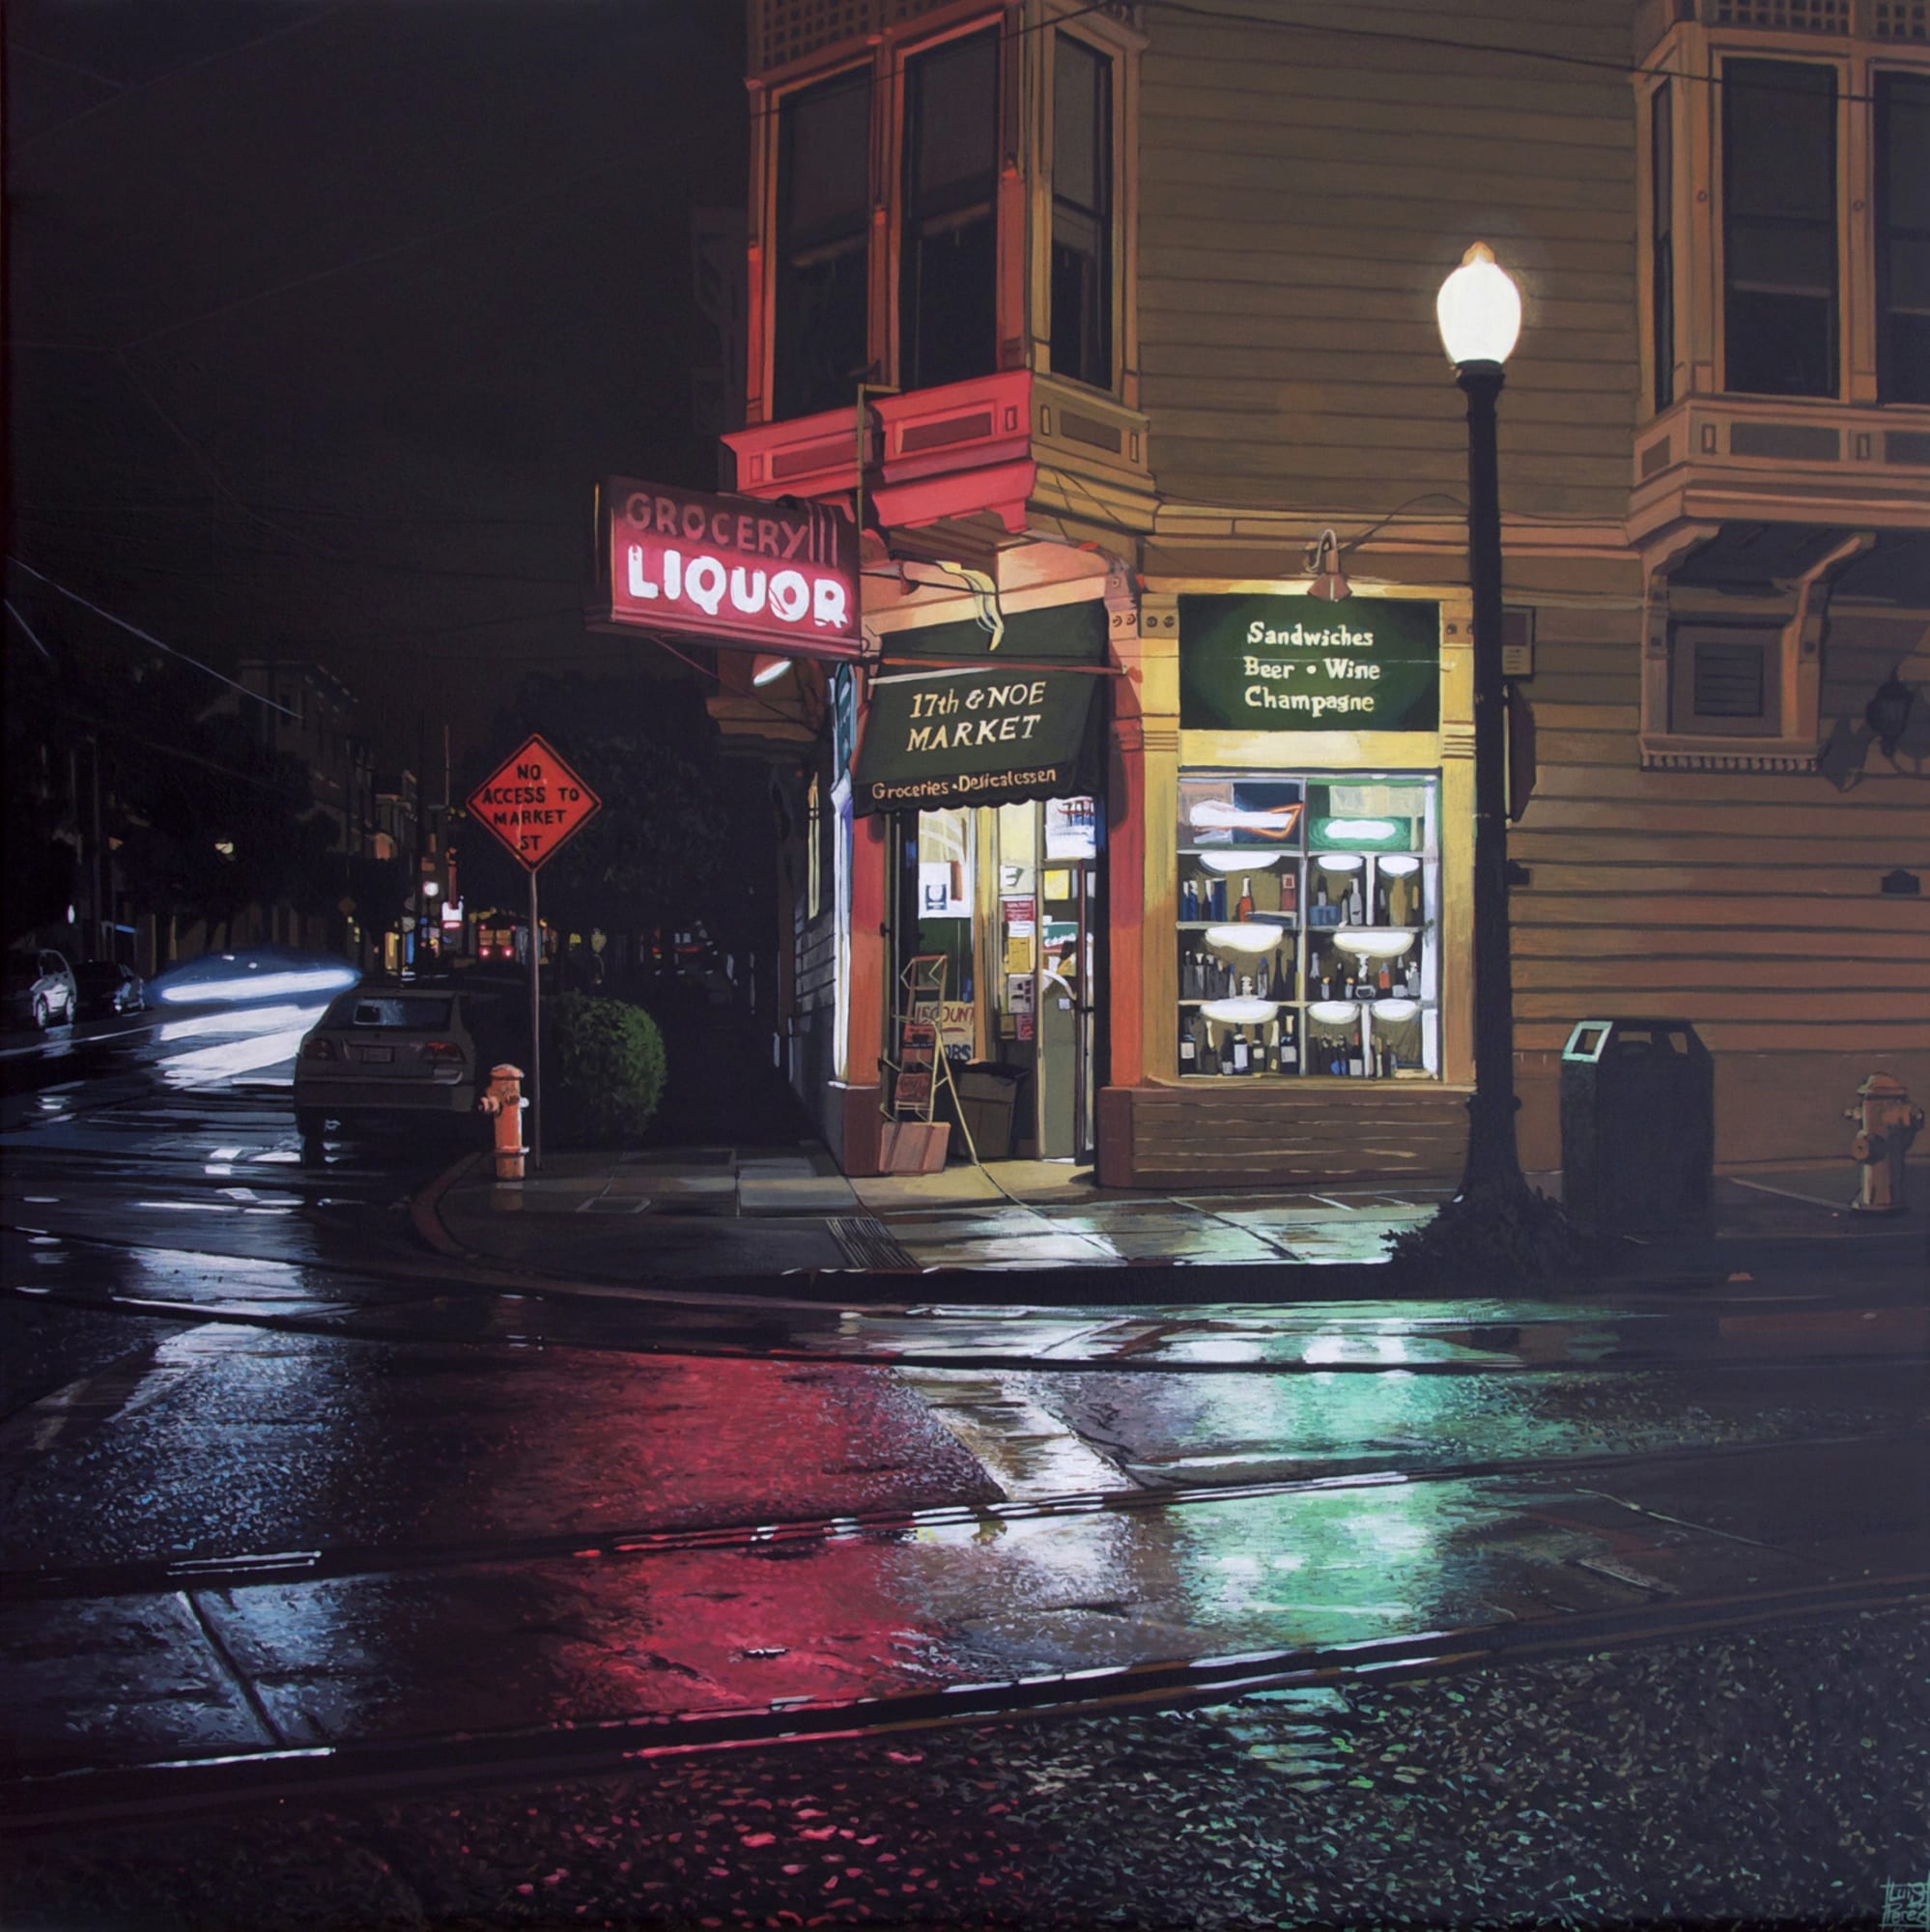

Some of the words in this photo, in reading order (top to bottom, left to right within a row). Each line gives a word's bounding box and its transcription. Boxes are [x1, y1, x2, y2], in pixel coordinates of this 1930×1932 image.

[626, 493, 808, 558] GROCERY
[628, 545, 848, 629] LIQUOR
[1247, 621, 1374, 646] Sandwiches
[1243, 656, 1295, 679] Beer
[1323, 658, 1380, 680] Wine
[909, 689, 959, 718] 17th
[965, 689, 985, 710] &
[987, 681, 1047, 709] NOE
[1244, 685, 1375, 718] Champagne
[906, 714, 1041, 753] MARKET
[516, 764, 542, 781] NO
[871, 780, 950, 800] Groceries
[958, 768, 1057, 793] Delicatessen
[482, 786, 546, 805] ACCESS
[558, 787, 580, 802] TO
[493, 810, 567, 826] MARKET
[520, 835, 542, 851] ST
